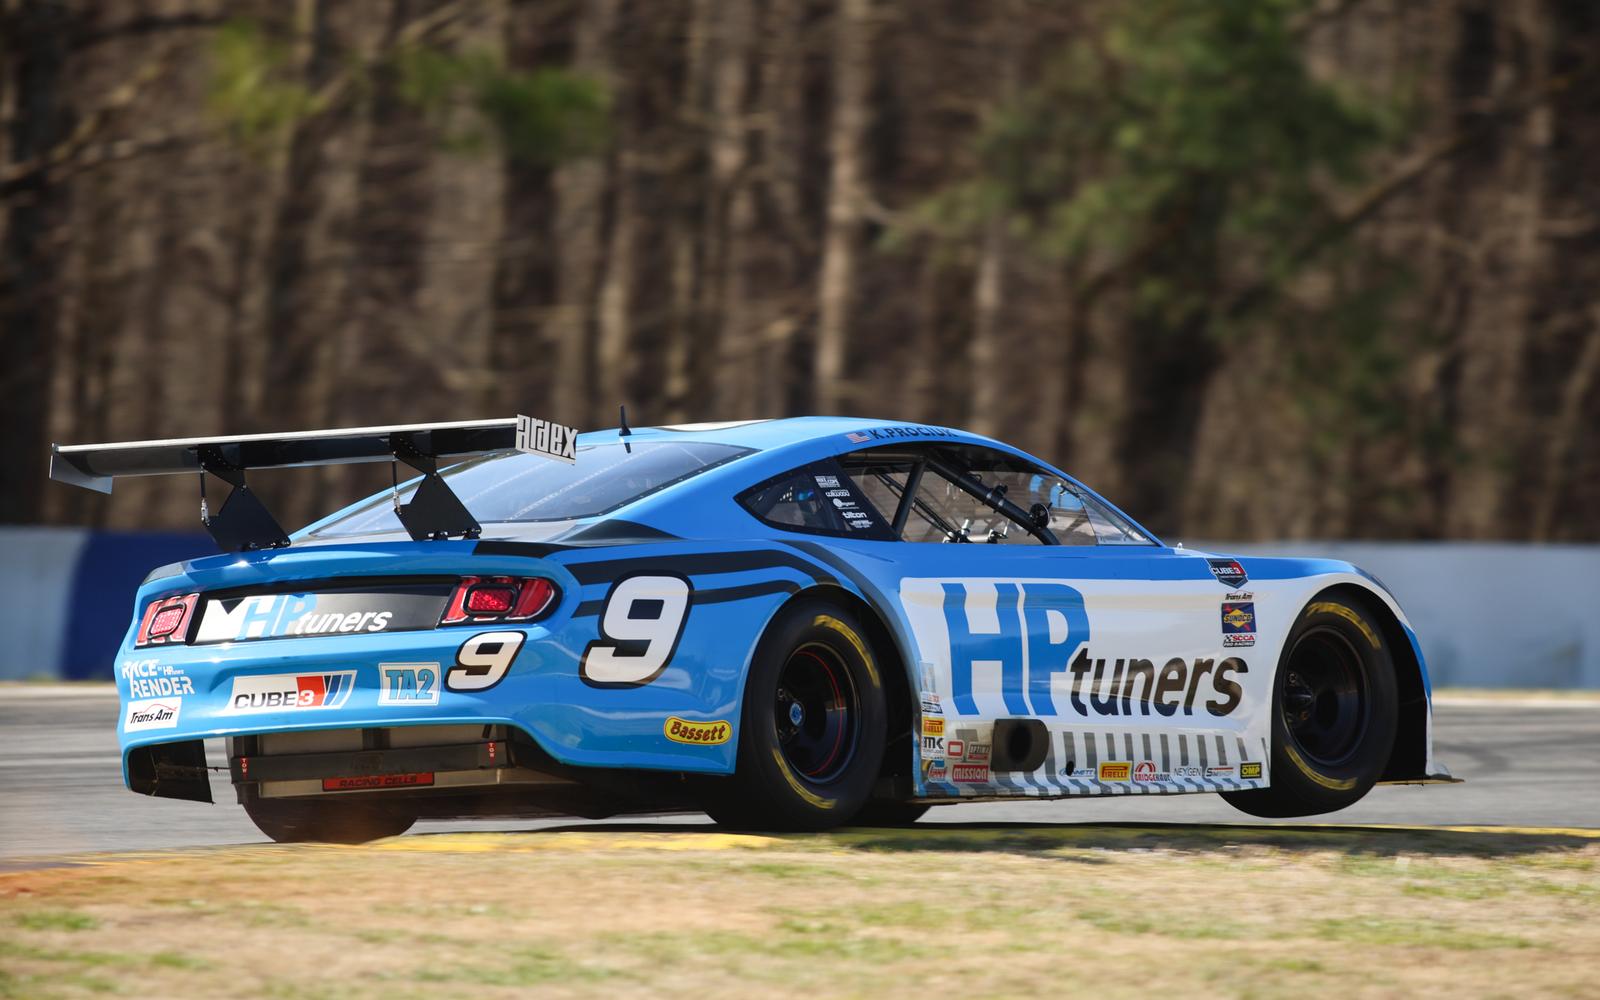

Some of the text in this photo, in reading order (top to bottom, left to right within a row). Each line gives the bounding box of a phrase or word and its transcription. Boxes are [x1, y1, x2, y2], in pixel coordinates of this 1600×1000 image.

[580, 570, 694, 689] 9
[121, 659, 160, 678] RACE
[445, 631, 527, 692] 9
[130, 676, 195, 698] RENDER
[384, 669, 436, 700] TA2
[130, 709, 174, 724] Trans Am
[671, 721, 726, 741] Bassett
[1102, 766, 1128, 778] PIRELLI
[1242, 766, 1260, 775] OMP
[339, 779, 382, 788] RACING
